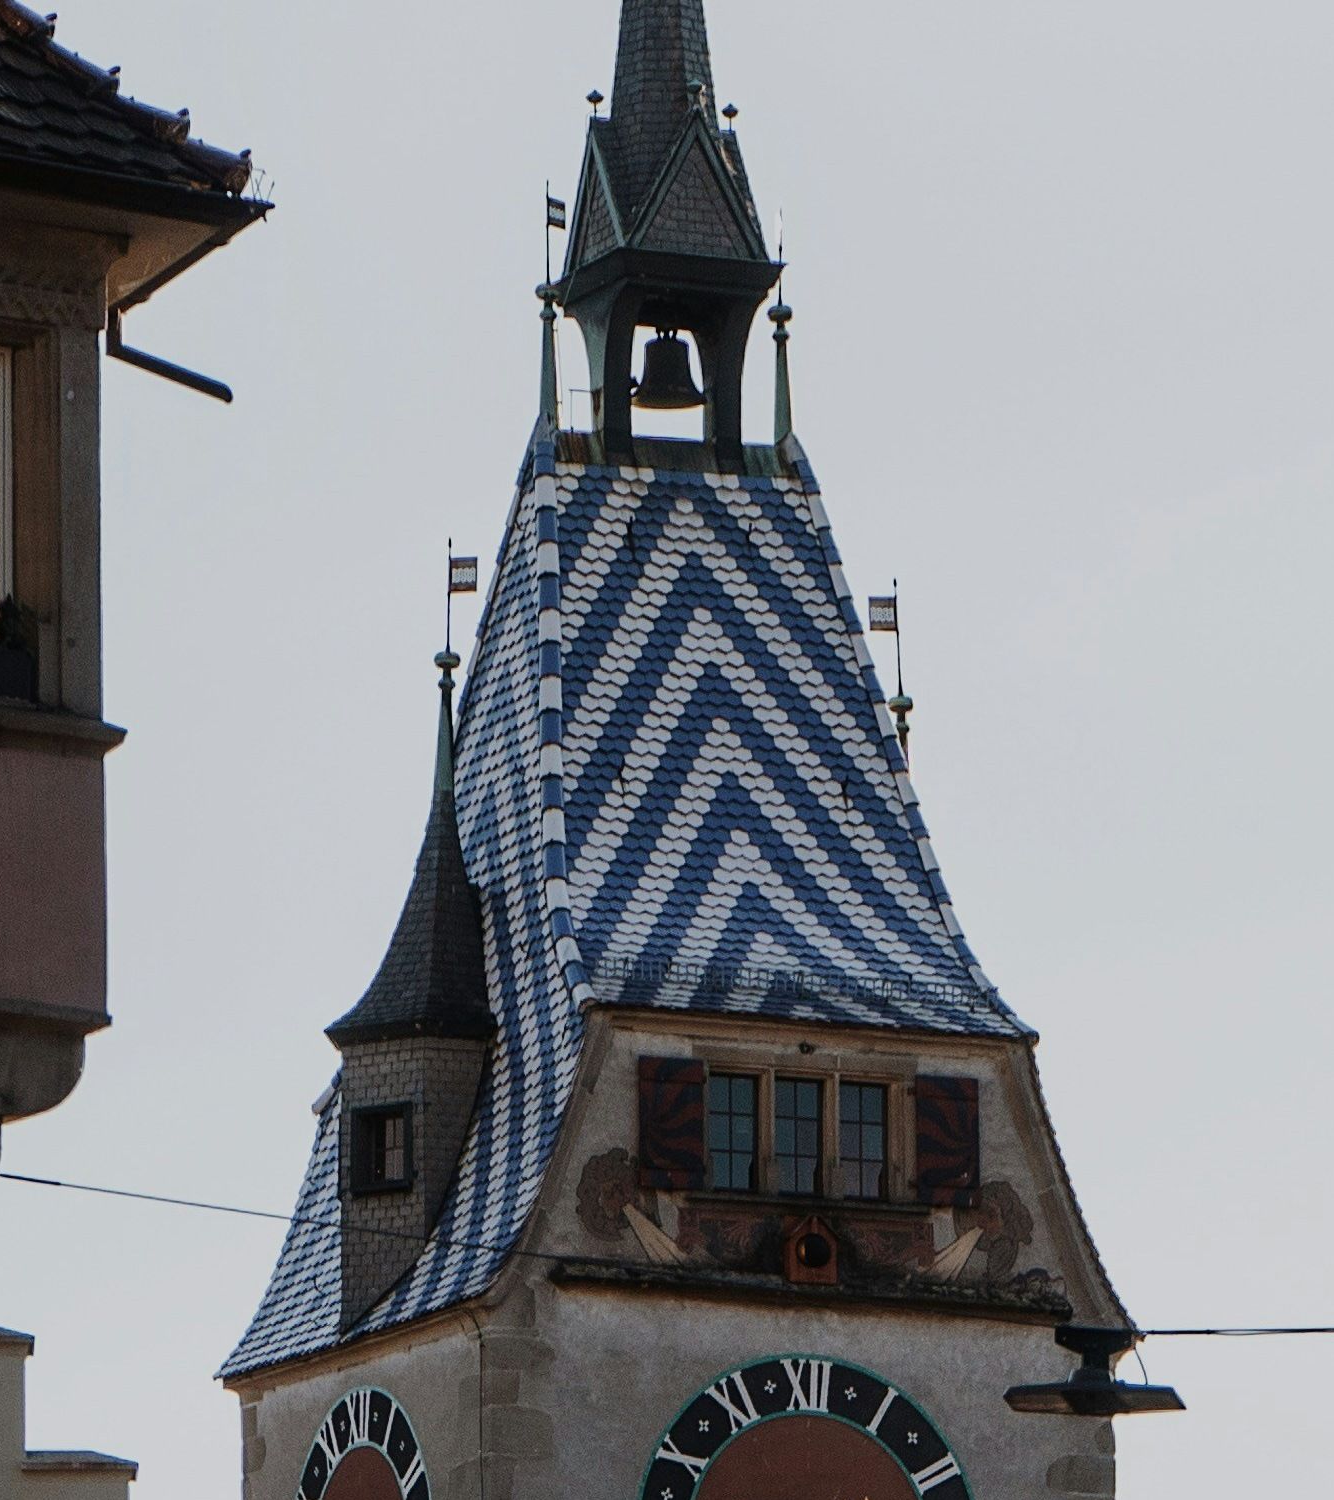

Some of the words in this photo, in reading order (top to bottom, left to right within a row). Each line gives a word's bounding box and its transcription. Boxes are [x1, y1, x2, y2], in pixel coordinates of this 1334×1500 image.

[705, 1370, 761, 1435] XI
[779, 1358, 833, 1413] XII
[867, 1386, 899, 1435] I
[656, 1434, 709, 1482] X
[911, 1452, 961, 1495] II
